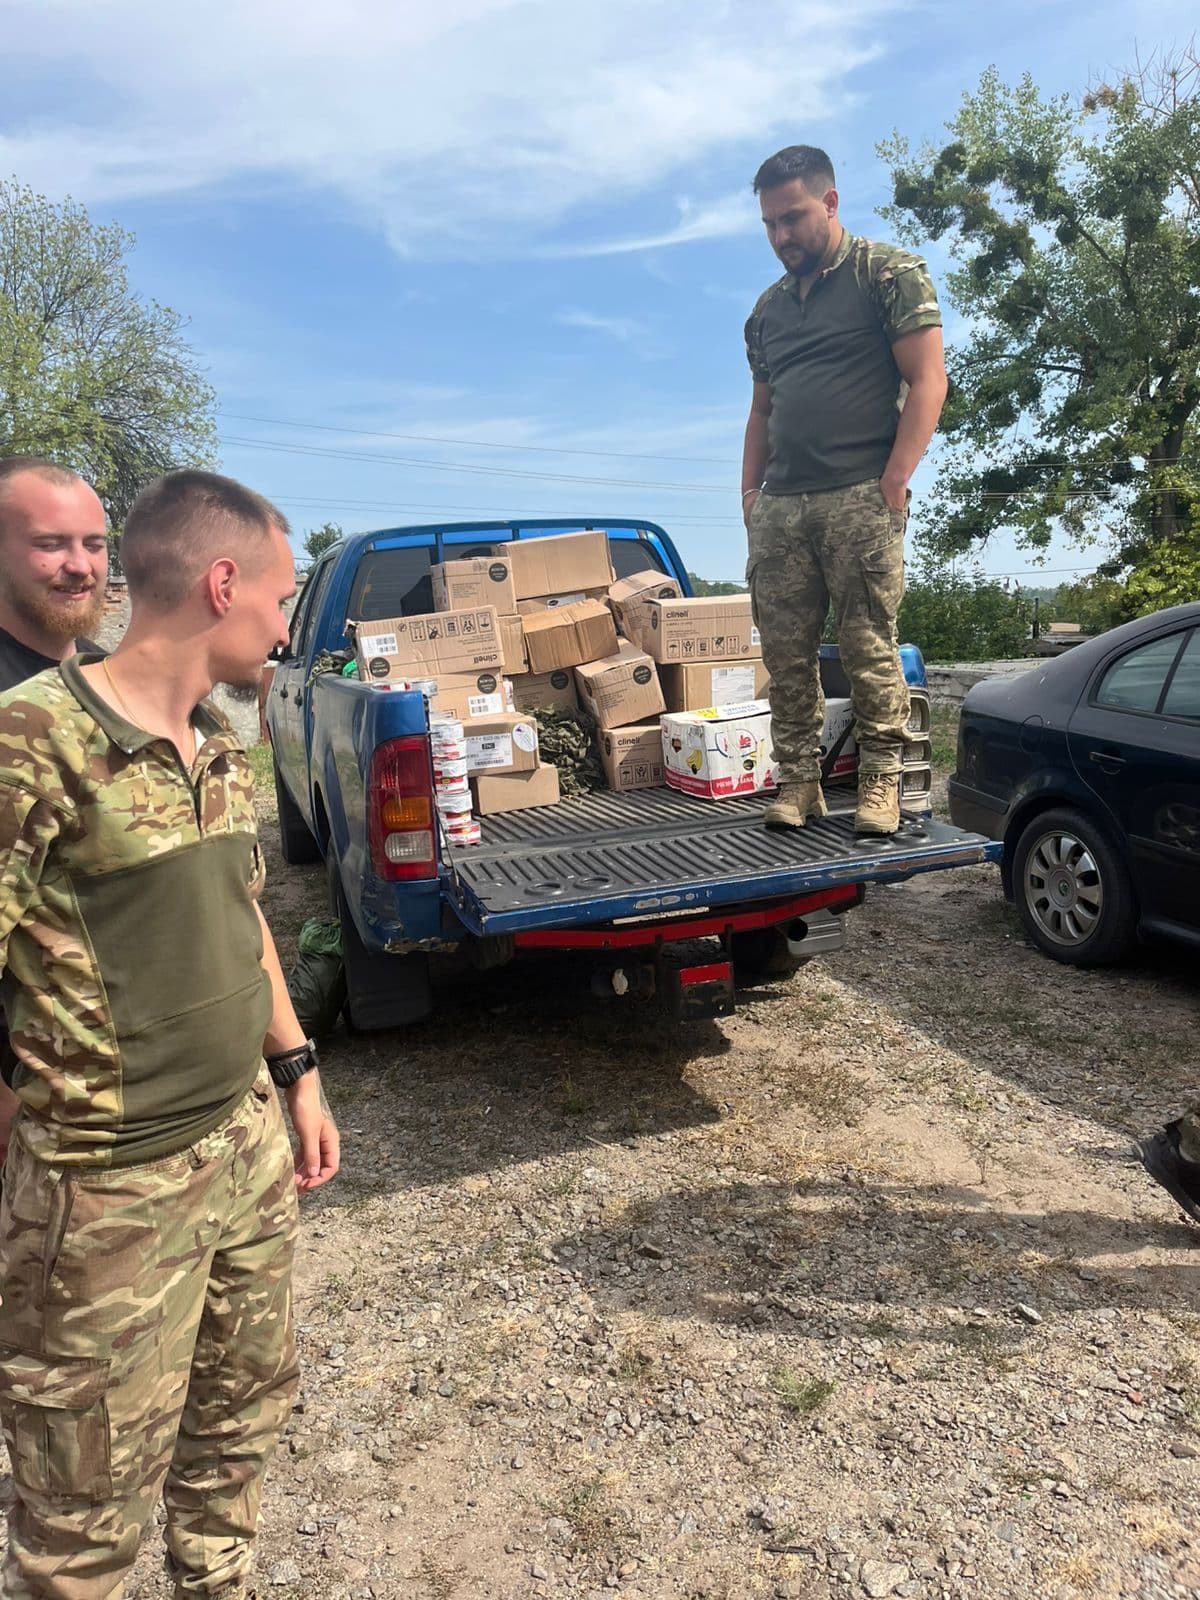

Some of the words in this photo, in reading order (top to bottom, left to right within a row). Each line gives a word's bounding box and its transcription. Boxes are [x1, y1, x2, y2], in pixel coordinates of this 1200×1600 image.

[666, 610, 688, 619] clinell
[473, 654, 498, 665] clinell
[617, 736, 640, 746] clinell
